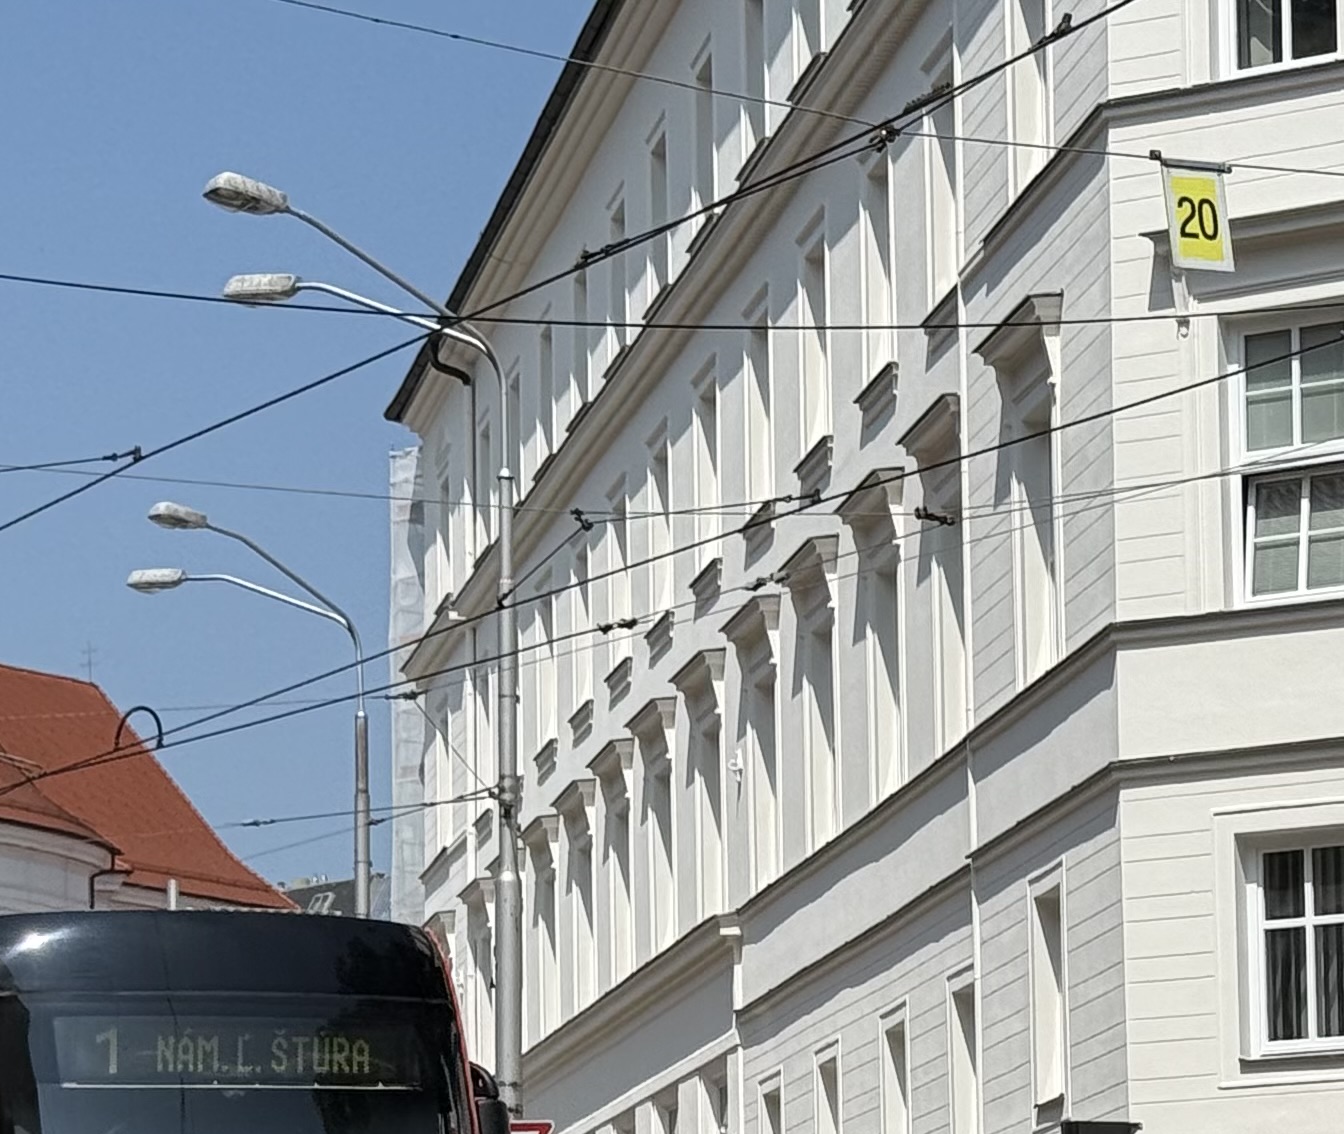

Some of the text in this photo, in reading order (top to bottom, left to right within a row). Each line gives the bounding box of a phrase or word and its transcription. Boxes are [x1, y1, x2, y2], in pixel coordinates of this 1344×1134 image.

[1178, 196, 1219, 241] 20
[96, 1028, 118, 1074] 1
[156, 1027, 229, 1074] NÁM.
[270, 1027, 371, 1074] ŠTÚRA
